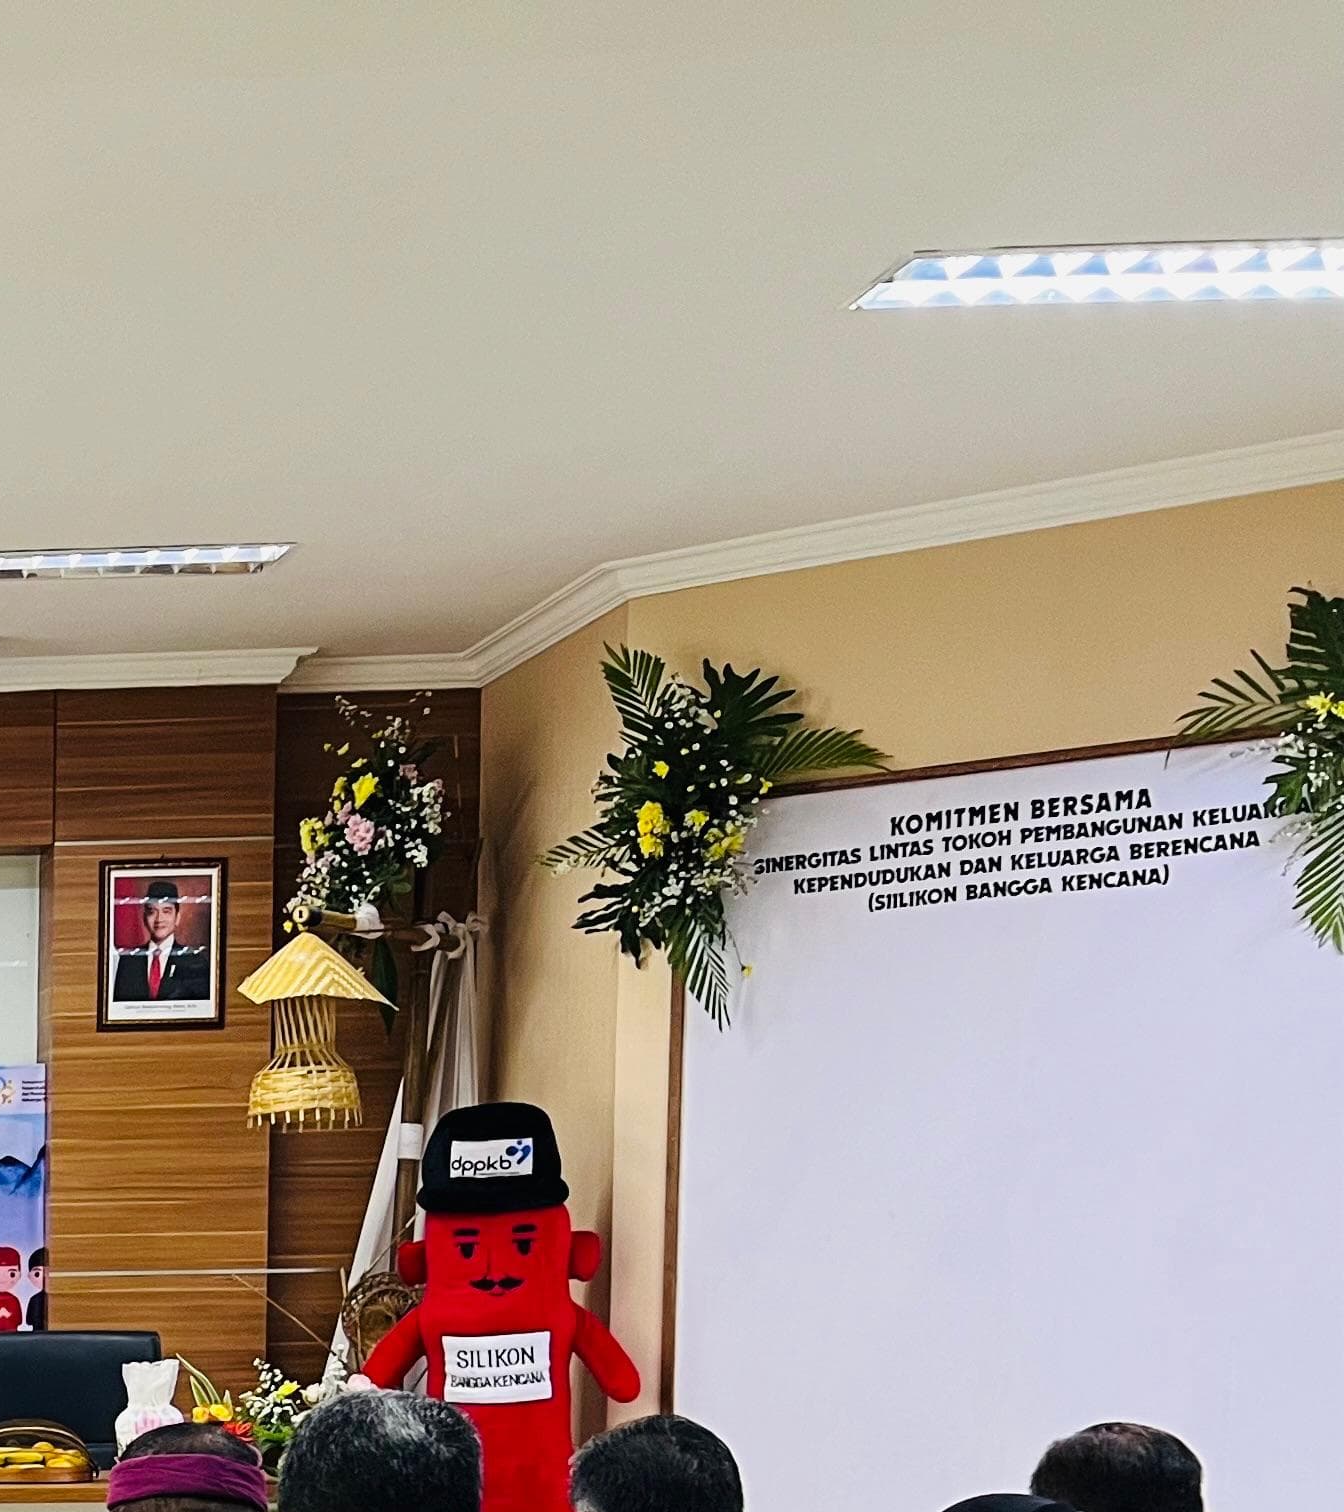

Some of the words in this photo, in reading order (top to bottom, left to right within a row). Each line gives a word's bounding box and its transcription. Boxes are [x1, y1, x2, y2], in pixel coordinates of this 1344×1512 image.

[890, 802, 1020, 837] KOMITMEN
[1030, 788, 1153, 820] BERSAMA
[868, 838, 934, 863] LINTAS
[941, 829, 1012, 853] TOKOH
[1020, 812, 1184, 845] PEMBANGUNAN
[793, 862, 952, 895] KEPENDUDUKAN
[959, 856, 1003, 876] DAN
[1010, 845, 1121, 871] KELUARGA
[1129, 830, 1260, 860] BERENCANA
[867, 886, 958, 913] (SIILIKON
[965, 876, 1053, 901] BANGGA
[1061, 864, 1170, 892] KENCANA)
[450, 1156, 513, 1176] dppkb
[456, 1346, 535, 1369] SILIKON
